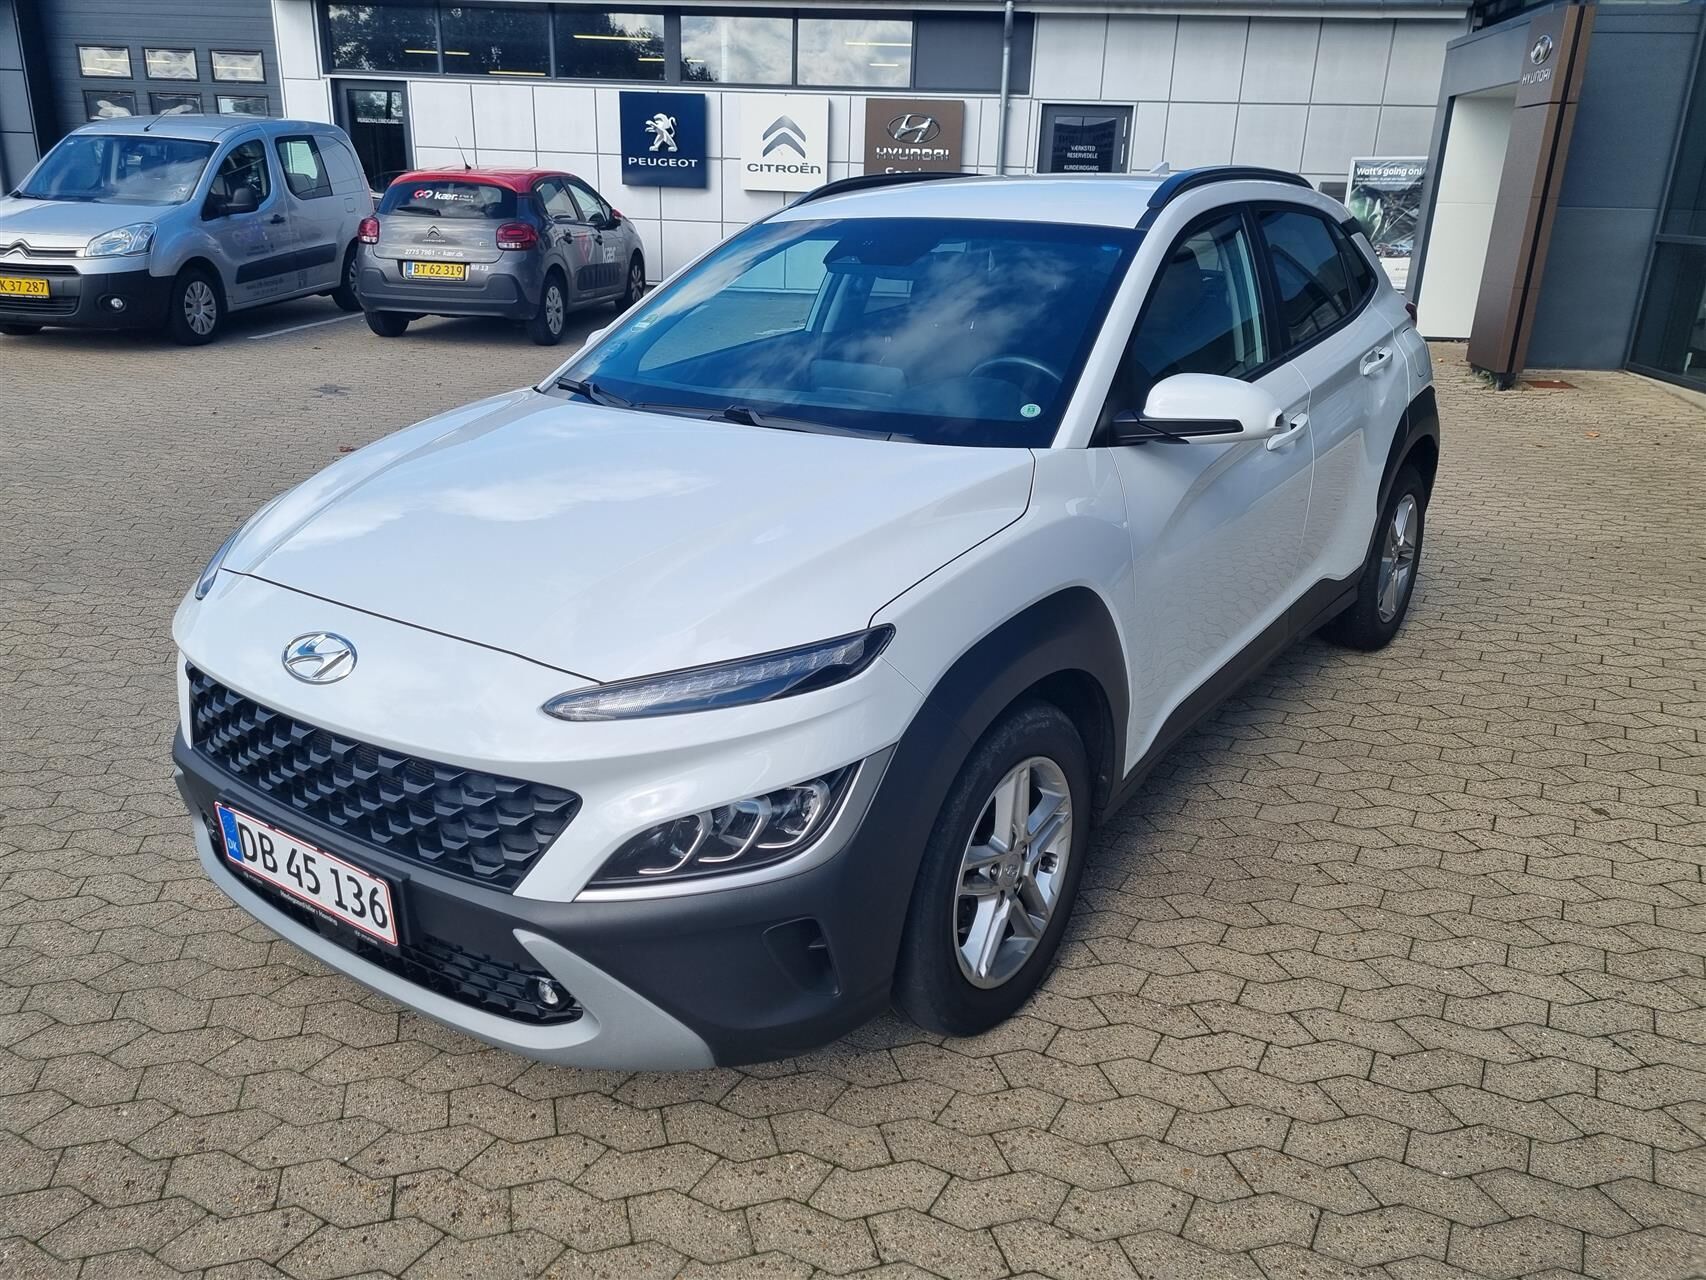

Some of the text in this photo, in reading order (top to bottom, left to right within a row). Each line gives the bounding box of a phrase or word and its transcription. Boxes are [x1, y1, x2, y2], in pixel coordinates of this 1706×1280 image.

[876, 147, 949, 160] HYUNDAI
[628, 157, 698, 168] PEUGEOT
[1356, 167, 1383, 176] Watt's
[1382, 167, 1408, 177] going
[413, 263, 463, 276] BT 62 319
[9, 280, 22, 292] 37
[25, 281, 45, 293] 287
[227, 837, 240, 853] DK
[237, 821, 278, 874] DB
[286, 847, 321, 895] 45
[329, 866, 388, 929] 136
